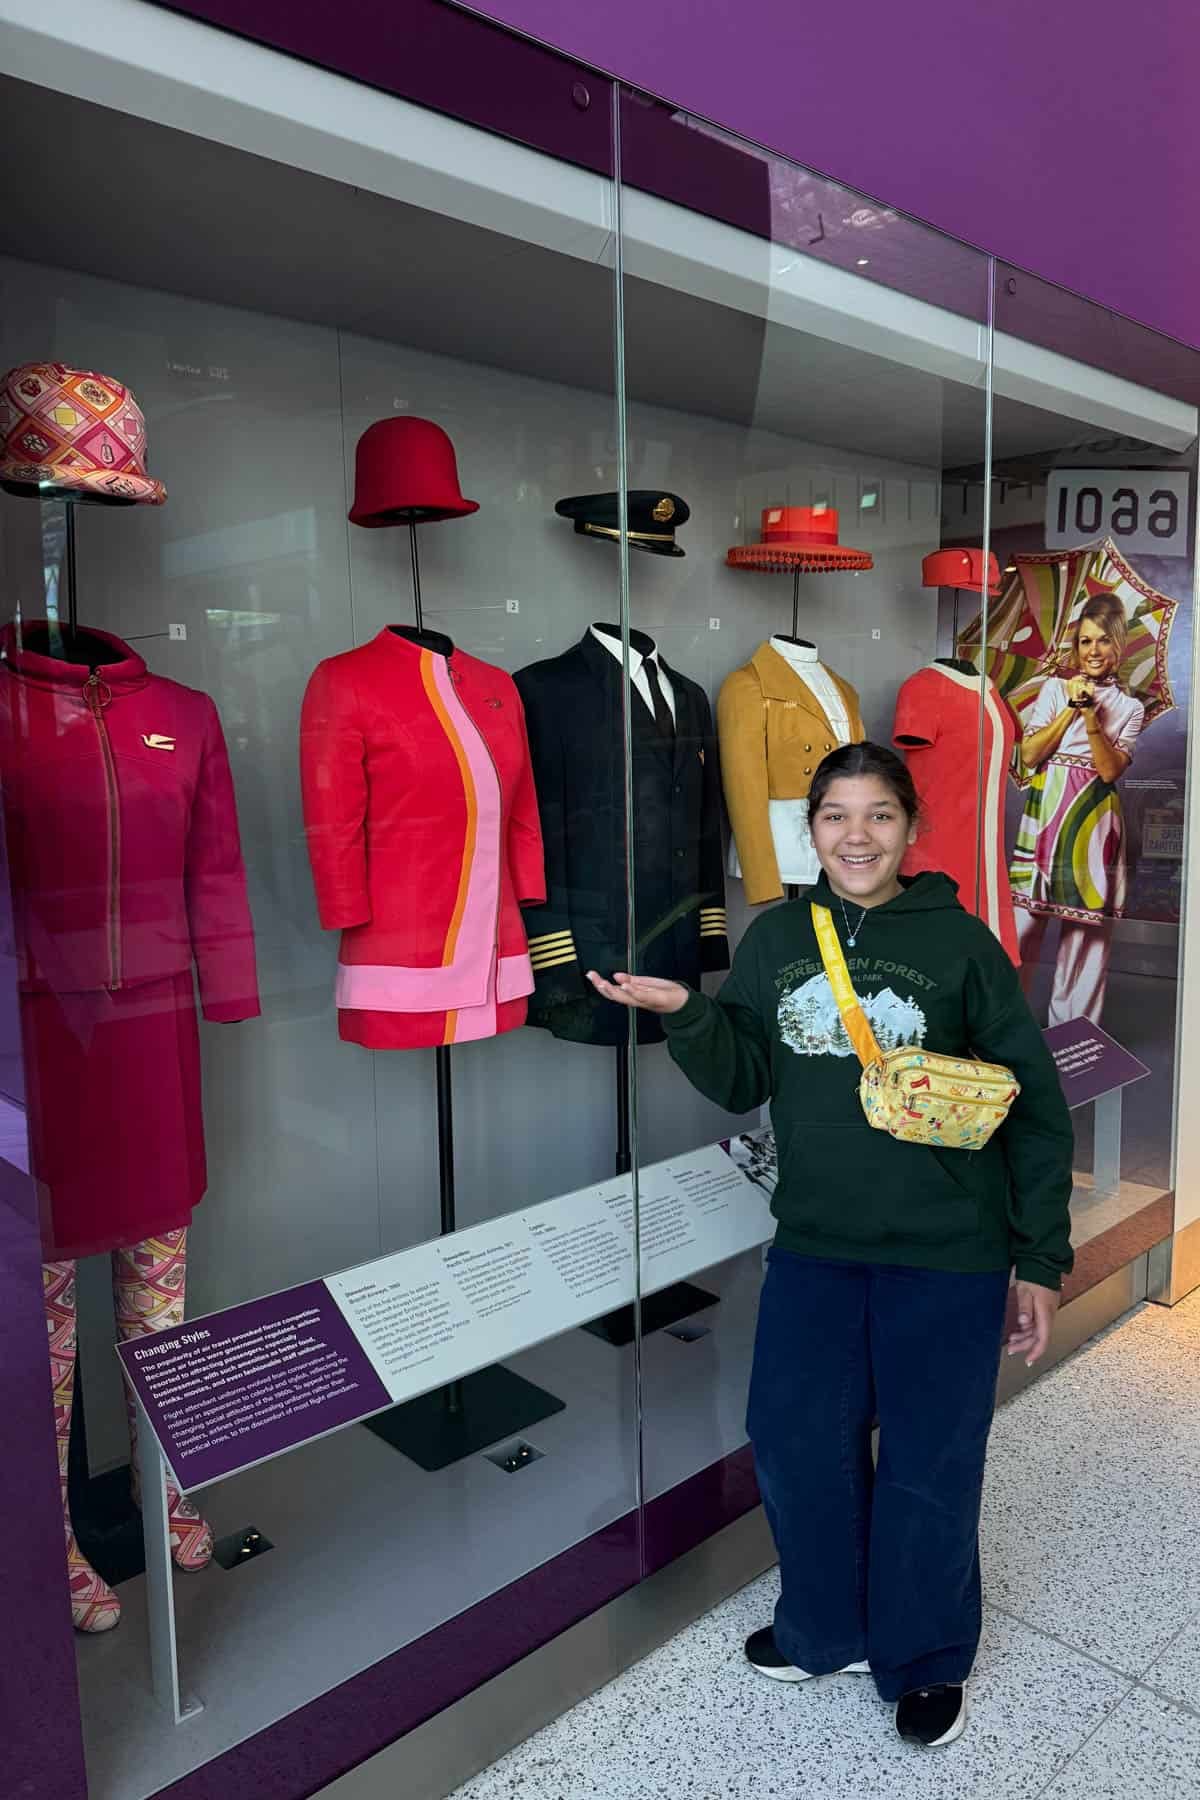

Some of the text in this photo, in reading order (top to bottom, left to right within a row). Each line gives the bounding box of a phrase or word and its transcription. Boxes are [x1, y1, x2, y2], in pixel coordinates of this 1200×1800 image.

[775, 958, 869, 990] FORBIEN
[874, 960, 938, 991] FOREST
[132, 1327, 211, 1361] Changing Styles
[139, 1361, 156, 1373] The
[154, 1349, 194, 1368] popularity
[190, 1346, 201, 1355] of
[199, 1343, 211, 1352] air
[209, 1336, 232, 1348] travel
[143, 1365, 177, 1381] Because
[175, 1362, 188, 1370] air
[186, 1355, 206, 1367] fares
[205, 1350, 224, 1360] were
[222, 1335, 265, 1354] government
[147, 1374, 181, 1390] resorted
[179, 1371, 190, 1379] to
[188, 1359, 225, 1376] attracting
[222, 1345, 265, 1364] passengers,
[151, 1376, 203, 1399] businessmen,
[201, 1370, 220, 1381] with
[218, 1364, 237, 1375] such
[277, 1342, 298, 1354] better
[156, 1393, 184, 1408] drinks,
[210, 1378, 226, 1388] and
[225, 1372, 244, 1382] even
[280, 1352, 298, 1362] staff
[161, 1408, 184, 1421] Flight
[183, 1396, 217, 1412] attendant
[244, 1375, 272, 1389] evolved
[166, 1414, 195, 1430] military
[192, 1411, 202, 1420] in
[201, 1397, 243, 1417] appearance
[240, 1393, 250, 1401] to
[248, 1384, 275, 1398] colorful
[273, 1379, 288, 1389] and
[170, 1421, 206, 1440] changing
[203, 1413, 226, 1426] social
[224, 1402, 255, 1418] attitudes
[253, 1398, 263, 1407] of
[261, 1394, 274, 1403] the
[293, 1383, 303, 1391] To
[301, 1375, 324, 1388] appeal
[322, 1371, 332, 1379] to
[174, 1430, 209, 1449] travelers,
[206, 1420, 234, 1435] airlines
[232, 1412, 254, 1425] chose
[252, 1400, 285, 1418] revealing
[178, 1440, 212, 1458] practical
[229, 1428, 239, 1437] to
[237, 1424, 251, 1434] the
[248, 1410, 286, 1429] discomfort
[283, 1407, 294, 1415] of
[291, 1400, 310, 1412] most
[308, 1393, 327, 1406] flight
